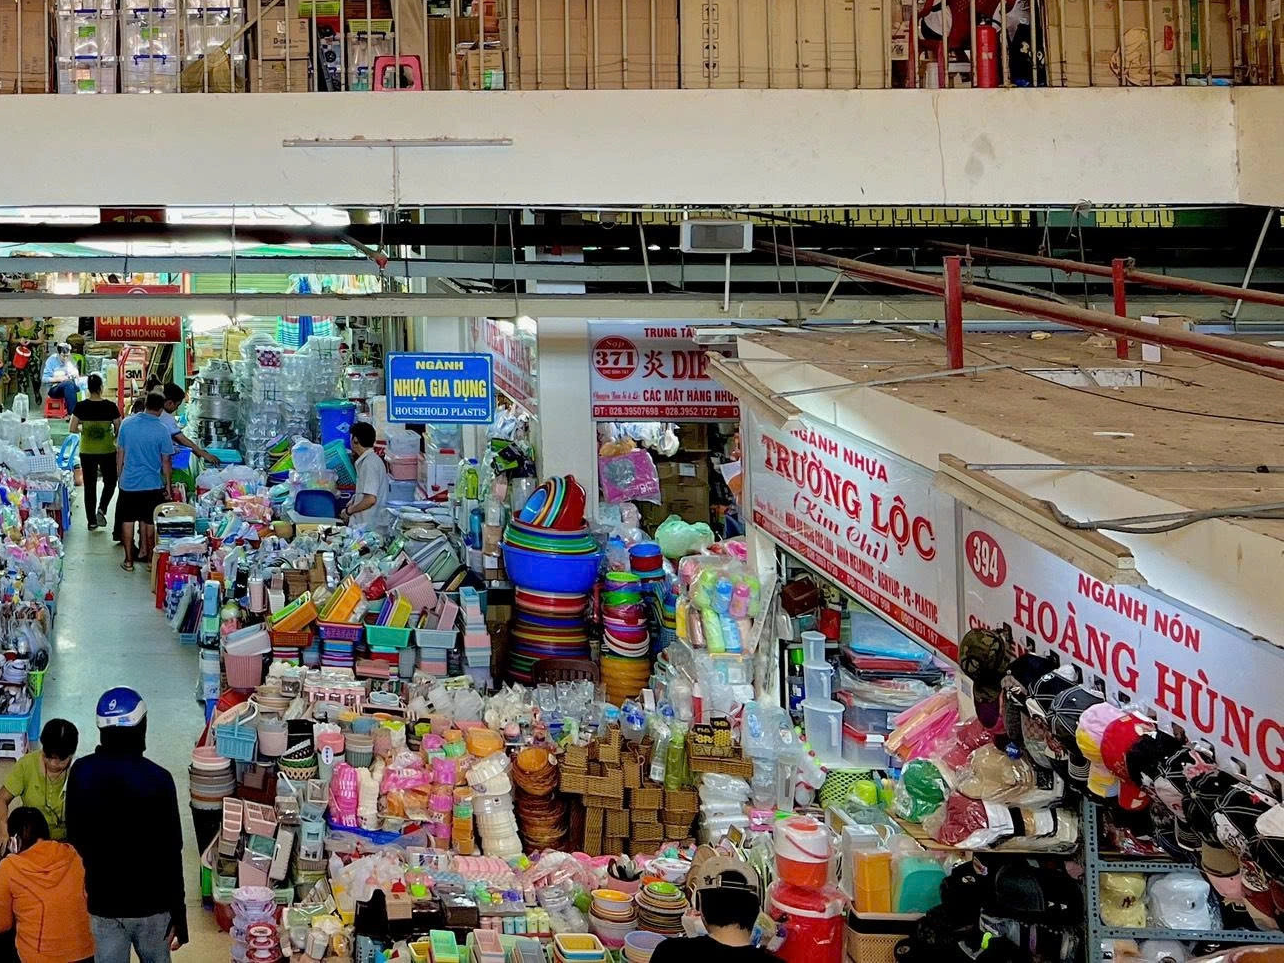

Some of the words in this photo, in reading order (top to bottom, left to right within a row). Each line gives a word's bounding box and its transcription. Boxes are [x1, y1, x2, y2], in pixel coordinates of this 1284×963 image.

[110, 329, 124, 338] NO
[125, 329, 166, 338] SMOKING
[644, 328, 677, 337] TRUNG
[416, 359, 463, 370] NGÀNH
[596, 351, 635, 366] 371
[642, 349, 668, 379] 炎
[125, 369, 143, 379] 3M
[394, 378, 426, 401] NHỰA
[430, 379, 450, 397] GIA
[454, 379, 487, 401] DỤNG
[643, 387, 661, 402] CÁC
[664, 388, 683, 404] MẶT
[687, 387, 711, 402] HÀNG
[395, 407, 448, 416] HOUSEHOLD
[451, 407, 487, 417] PLASTIS
[844, 448, 888, 484] NHỰA
[761, 433, 862, 522] TRƯỜNG
[870, 492, 936, 561] LỘC
[972, 536, 998, 582] 394
[915, 592, 938, 624] PLASTIC
[1078, 572, 1148, 625] NGÀNH
[1154, 609, 1201, 653] NÓN
[1013, 585, 1140, 693] HOÀNG
[1154, 660, 1284, 773] HÙNG
